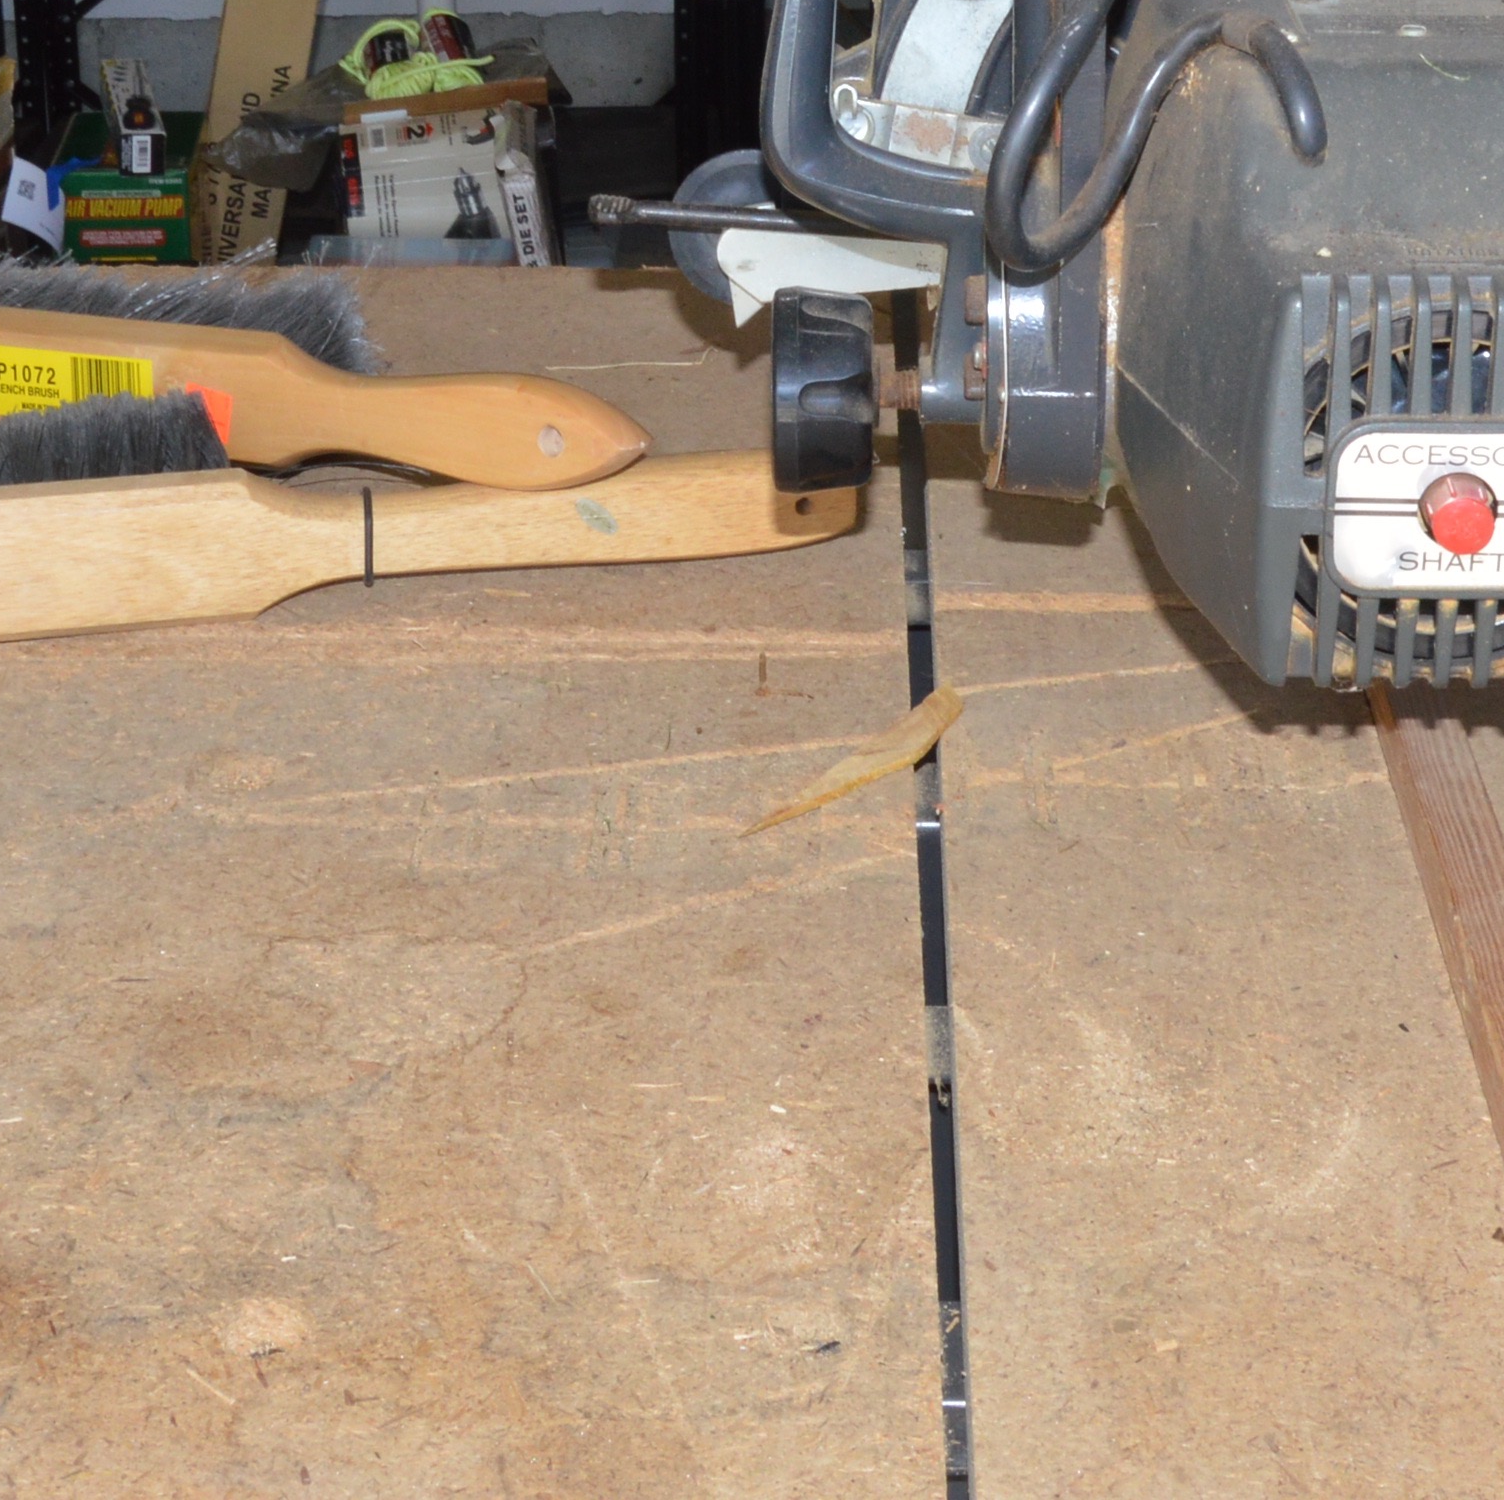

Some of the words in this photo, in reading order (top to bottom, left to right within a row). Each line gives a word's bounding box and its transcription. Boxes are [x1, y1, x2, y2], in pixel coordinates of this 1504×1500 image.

[406, 123, 426, 141] 2
[66, 200, 86, 217] AIR
[90, 198, 141, 217] VACUUM
[145, 198, 183, 217] PUMP
[512, 193, 528, 224] SET
[517, 229, 534, 255] DIE
[27, 385, 60, 399] BRUSH
